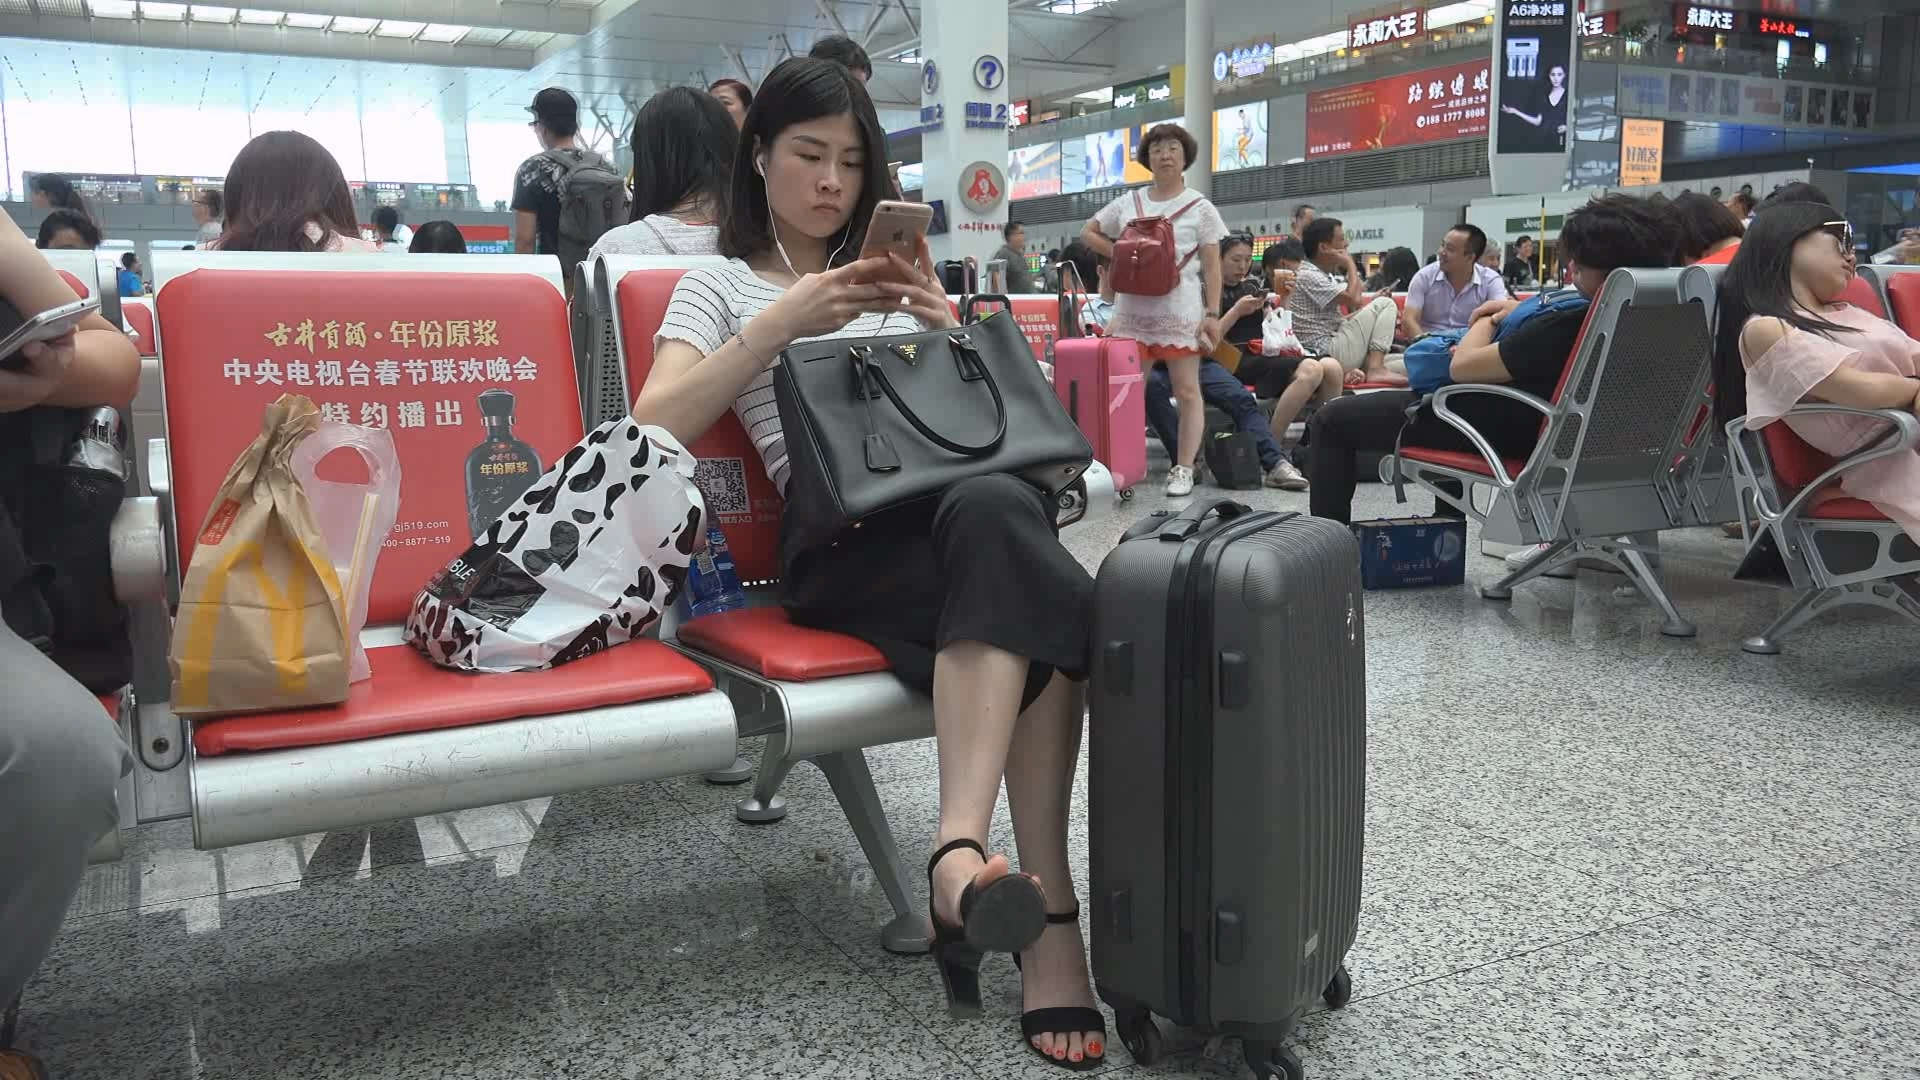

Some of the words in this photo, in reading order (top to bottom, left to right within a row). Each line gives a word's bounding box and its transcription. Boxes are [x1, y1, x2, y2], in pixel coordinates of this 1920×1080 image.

[1509, 4, 1565, 17] A6净水器
[1687, 8, 1733, 30] 永和大王
[1353, 12, 1417, 48] 永和大王
[996, 104, 1007, 119] 2
[1443, 111, 1462, 124] 1777
[223, 356, 538, 387] 中央电视台春节联欢晚会
[480, 462, 529, 476] 年份原浆
[394, 519, 450, 533] gj519.com
